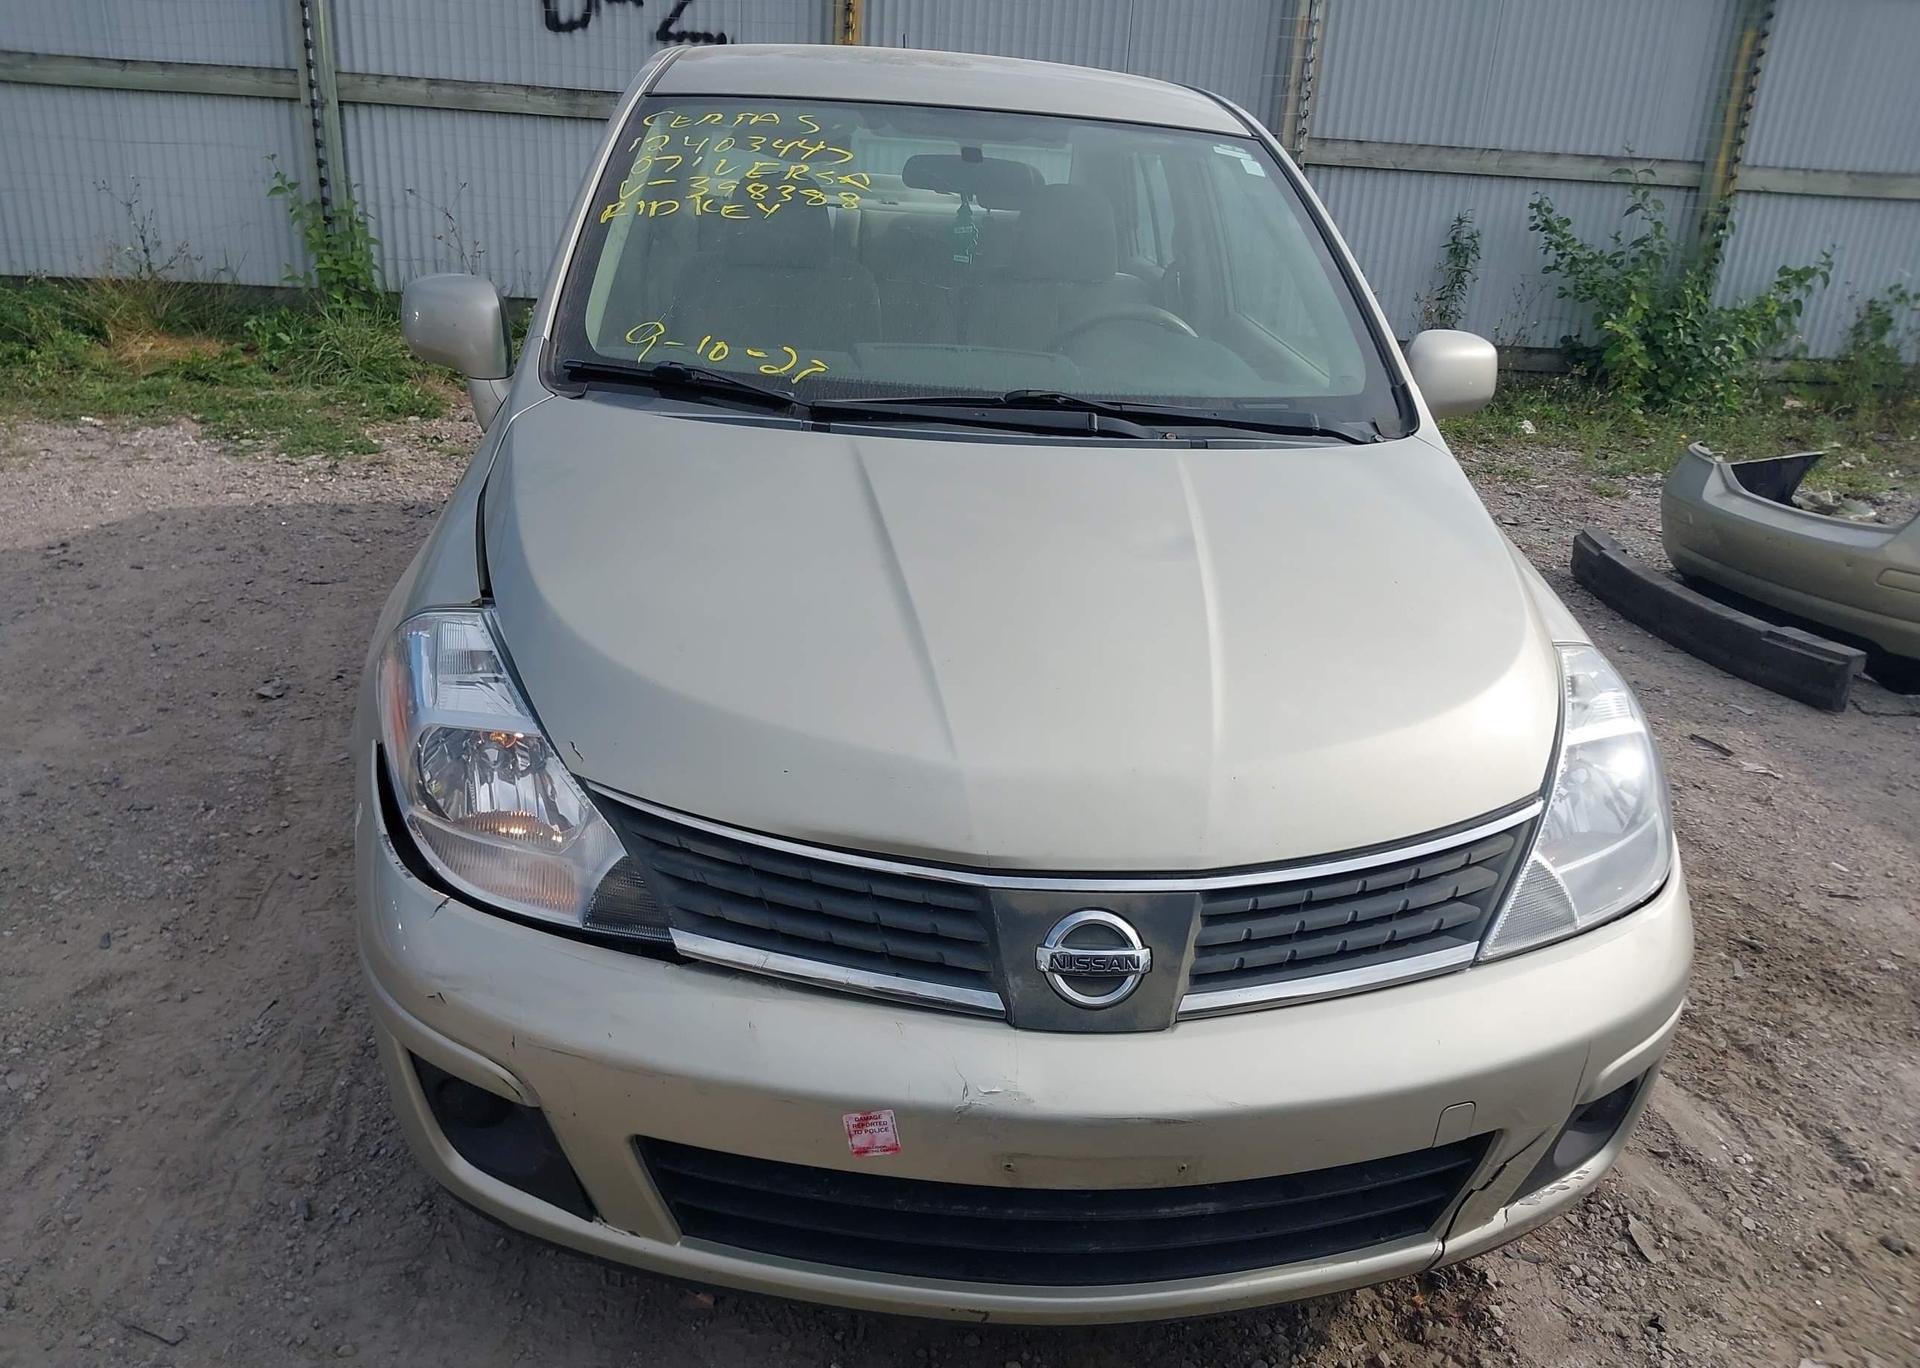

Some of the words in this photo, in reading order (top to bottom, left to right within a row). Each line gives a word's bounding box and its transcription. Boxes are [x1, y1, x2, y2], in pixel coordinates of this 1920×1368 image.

[1049, 953, 1140, 972] NISSAN
[854, 1114, 883, 1122] DAMAGE
[852, 1120, 888, 1129] REPORTED
[864, 1126, 890, 1134] POLICE
